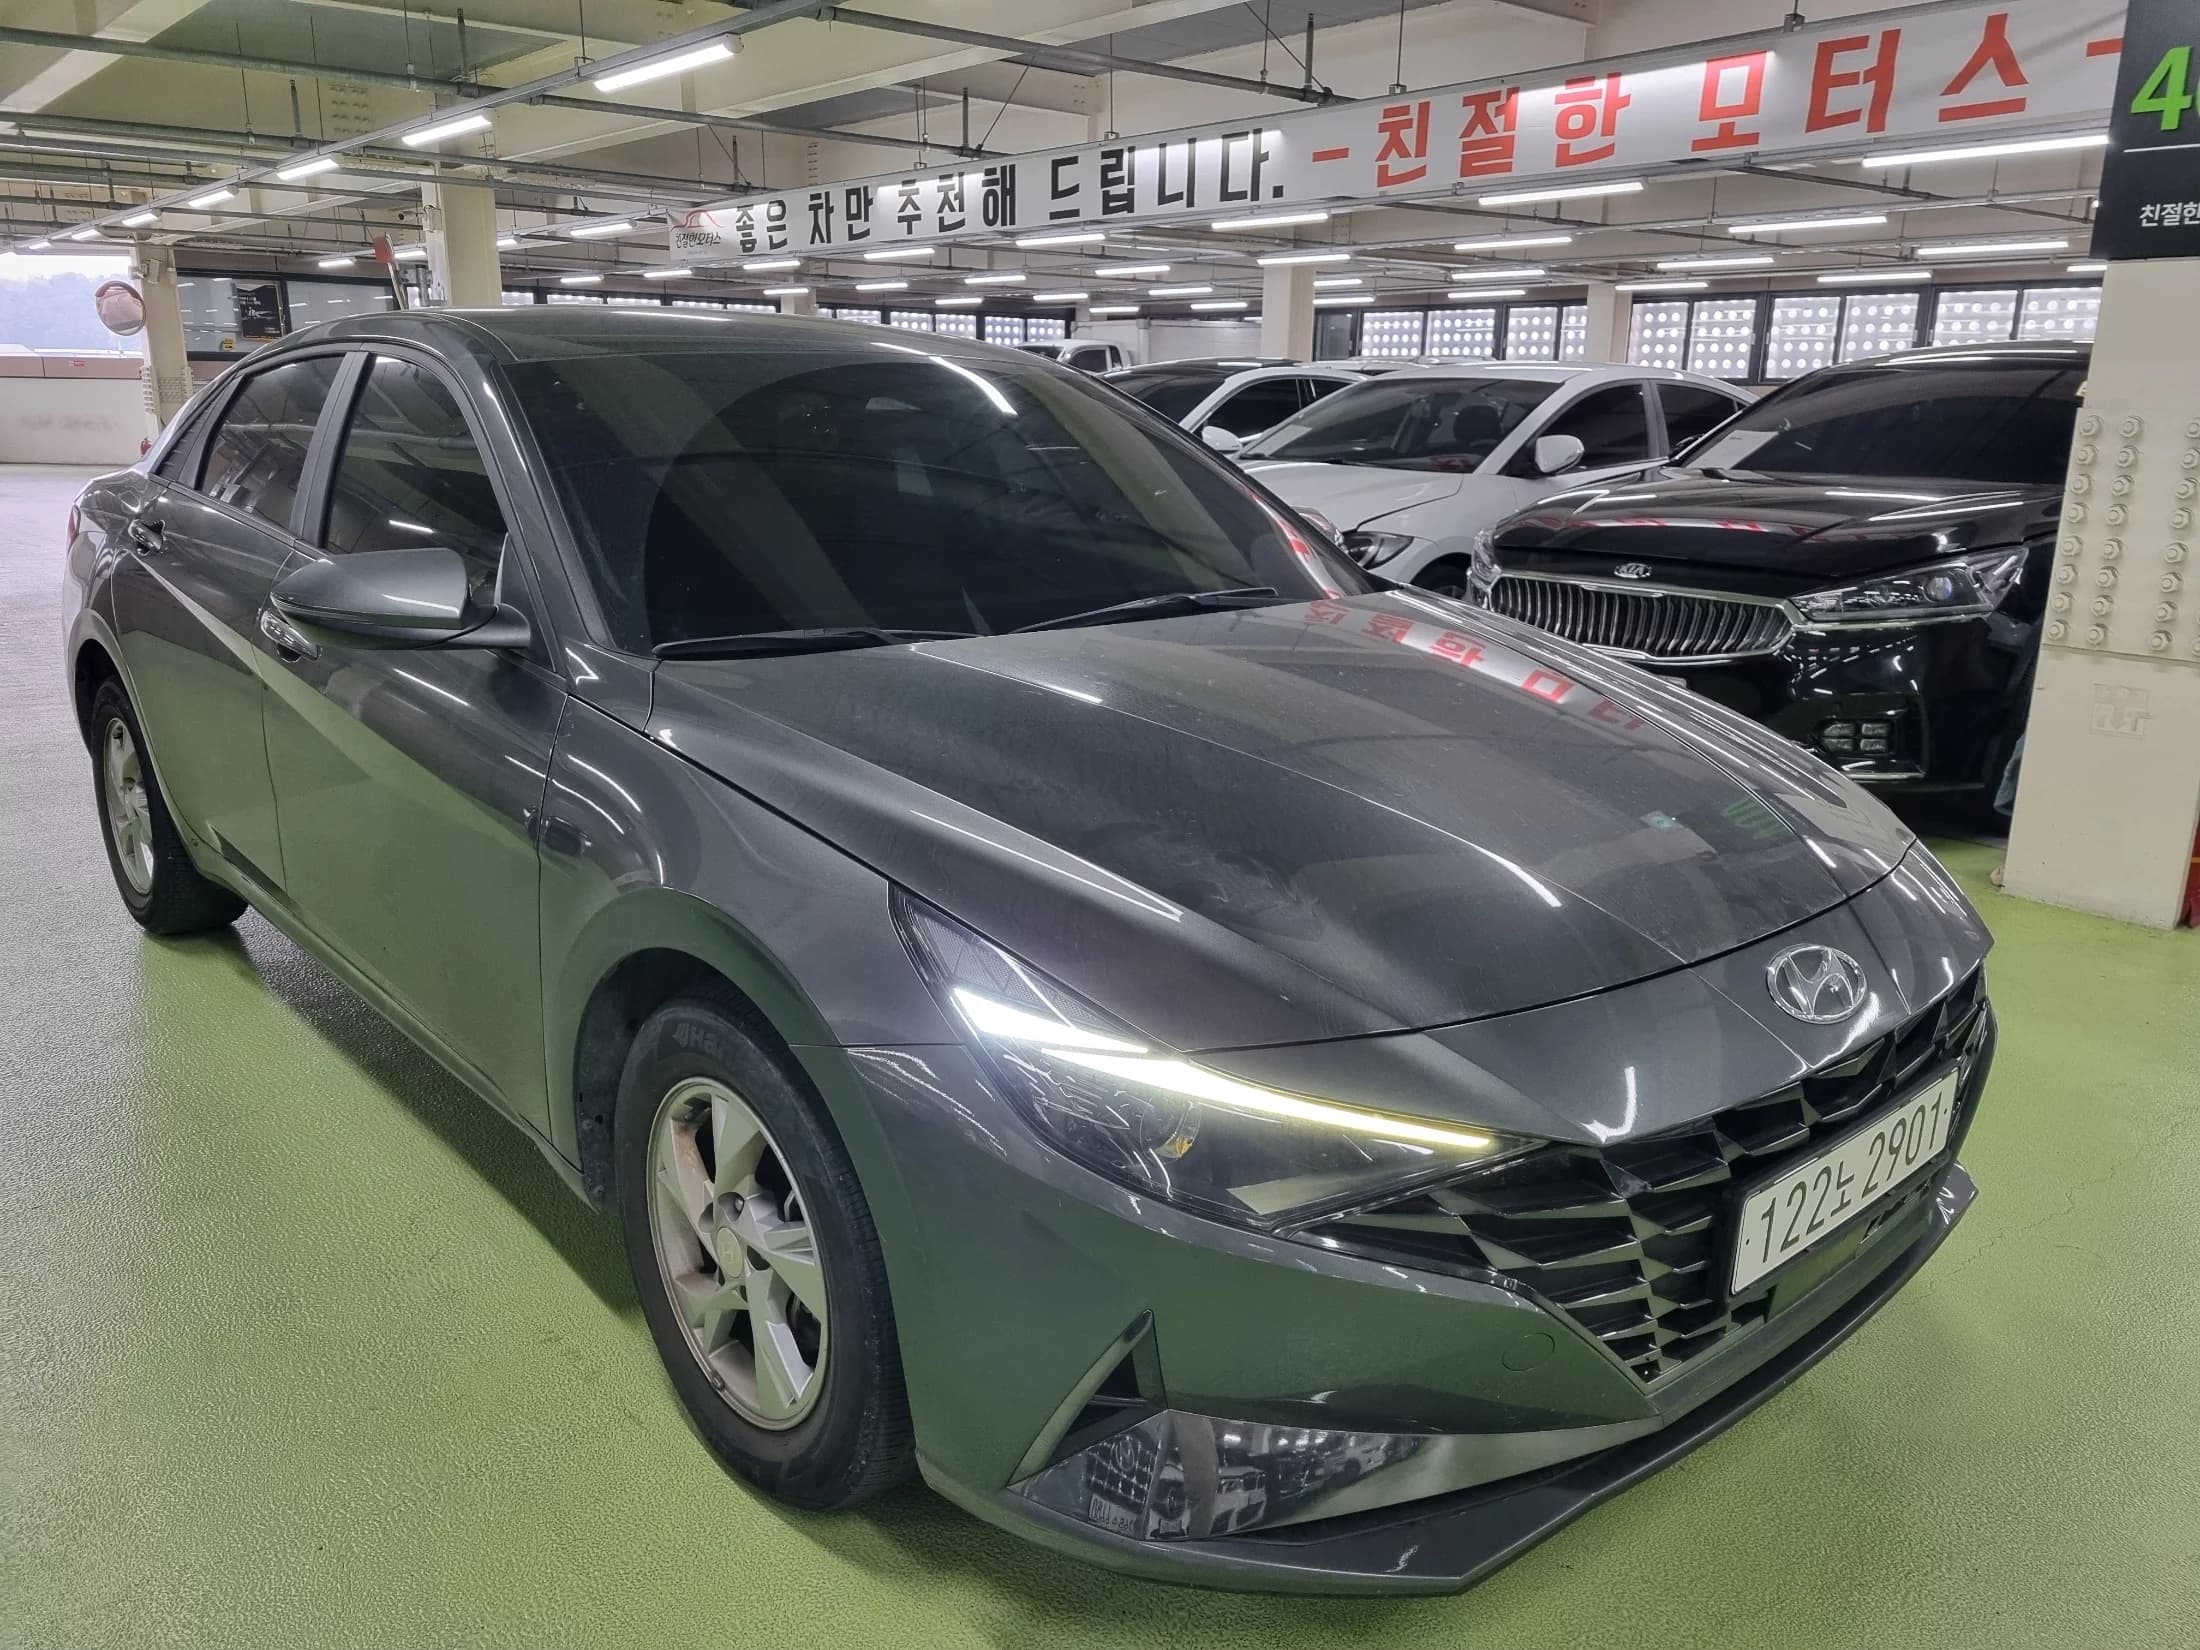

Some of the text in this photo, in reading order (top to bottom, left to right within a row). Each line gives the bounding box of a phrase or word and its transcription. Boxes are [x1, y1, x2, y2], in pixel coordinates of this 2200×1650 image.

[735, 199, 788, 254] 좋은
[808, 185, 874, 245] 차만
[896, 167, 1016, 236] 추천해
[1049, 127, 1284, 218] 드립니다.
[1374, 71, 1632, 188] 친절한
[1691, 12, 2030, 152] 모터스
[2131, 46, 2200, 131] 4
[1761, 1090, 1943, 1264] 122노 2901
